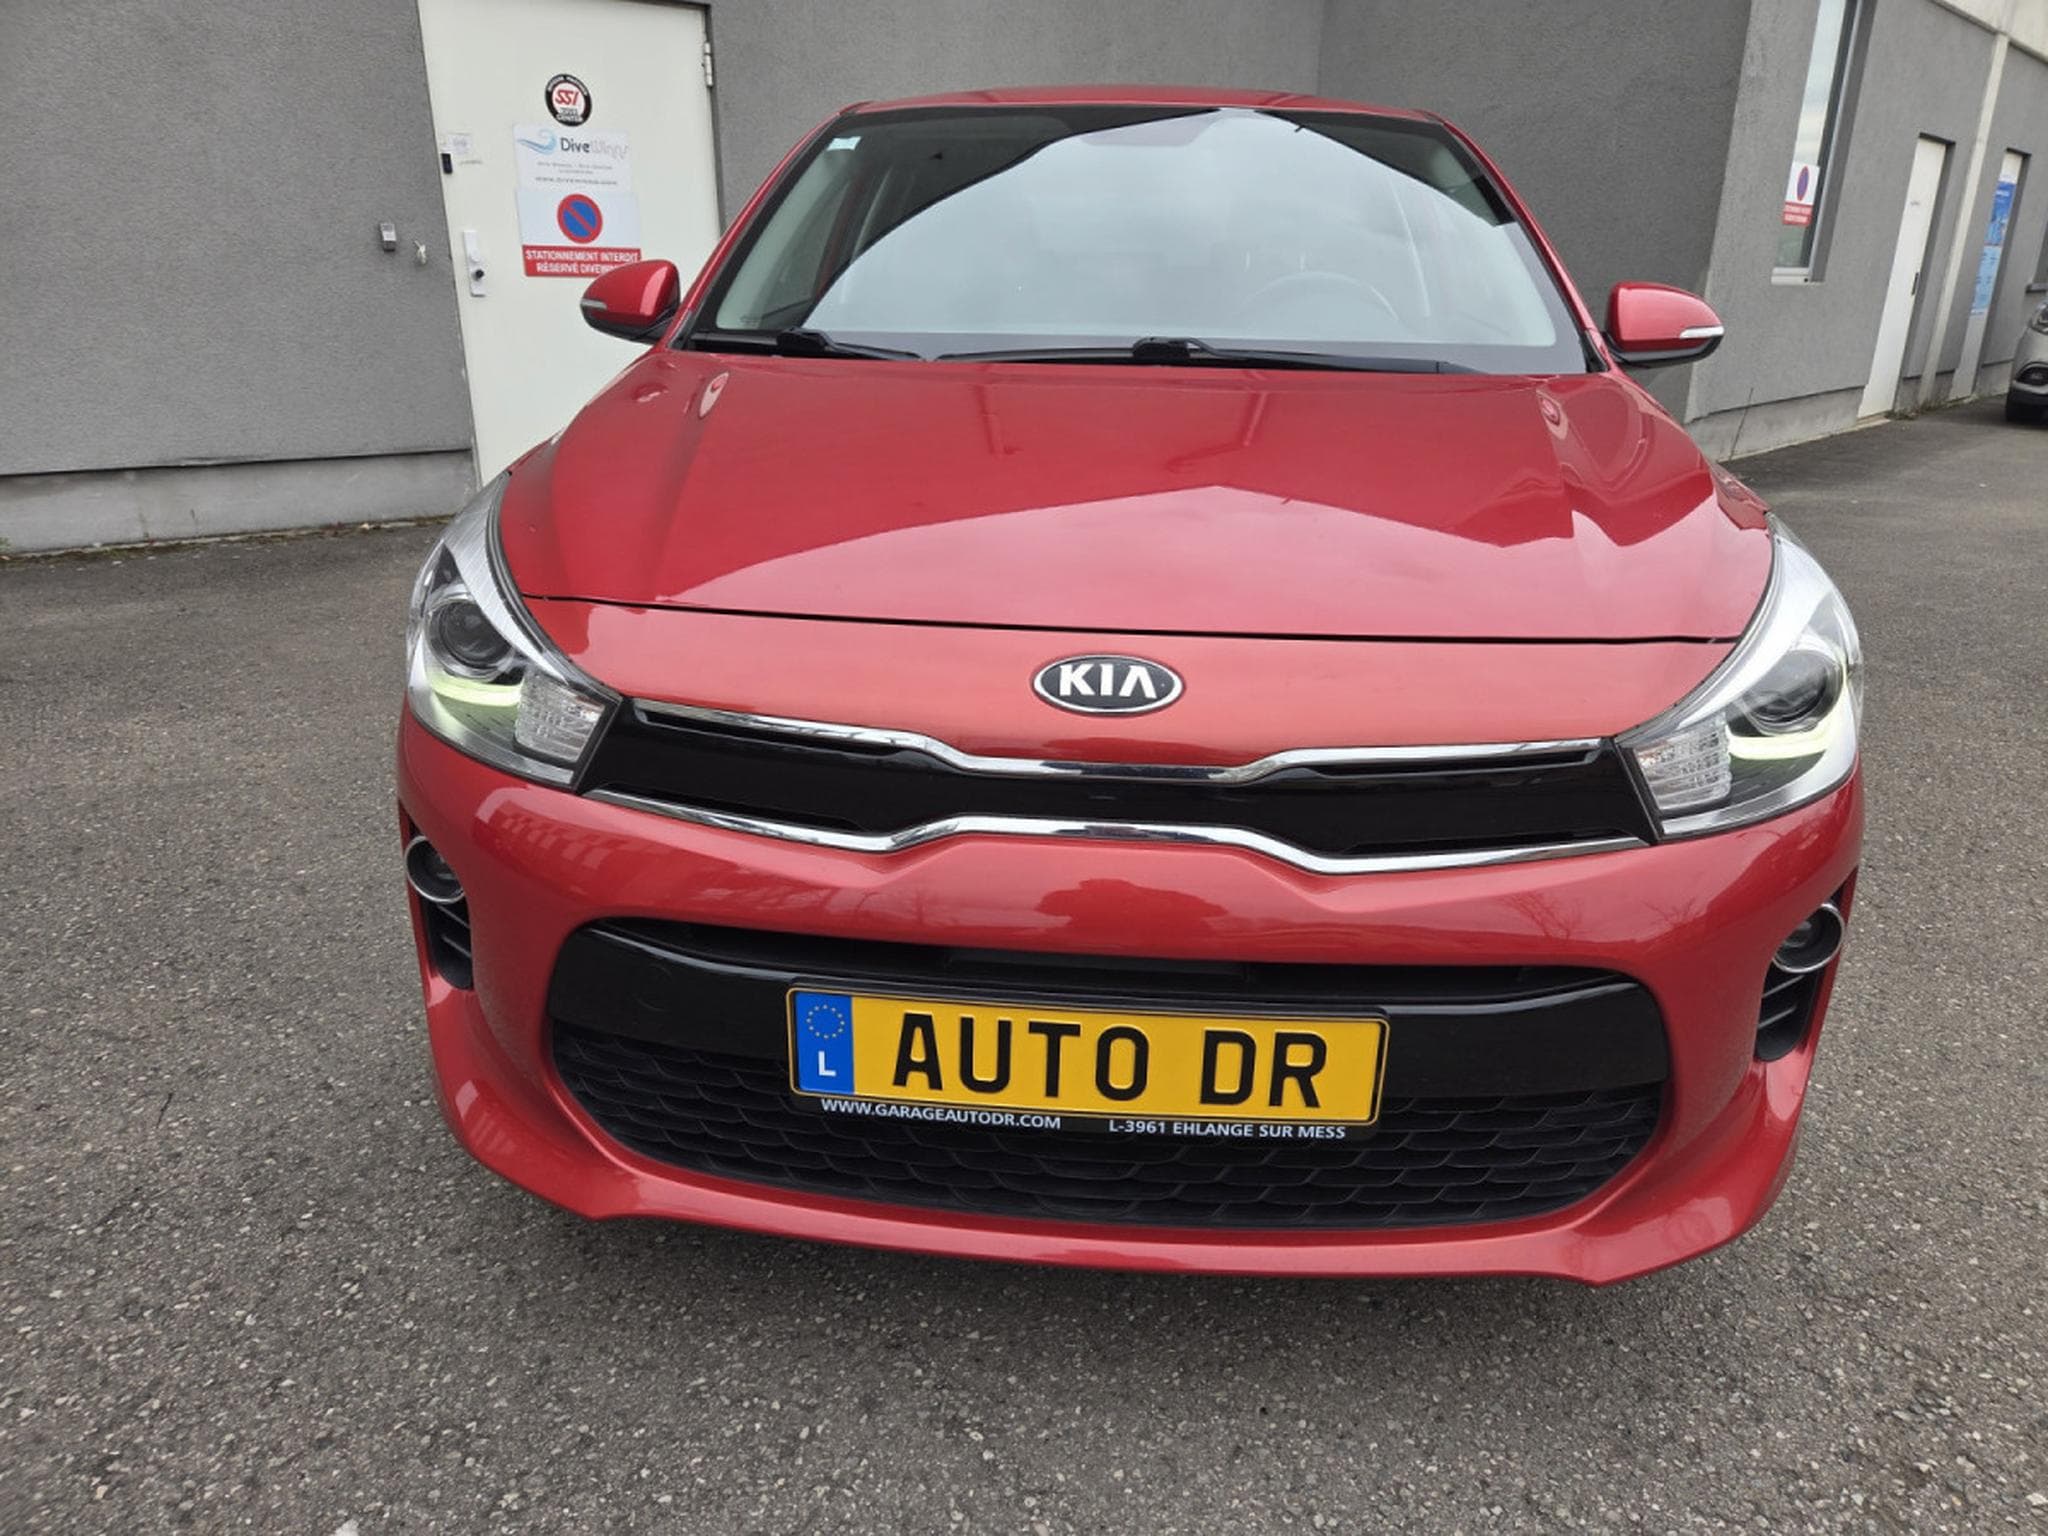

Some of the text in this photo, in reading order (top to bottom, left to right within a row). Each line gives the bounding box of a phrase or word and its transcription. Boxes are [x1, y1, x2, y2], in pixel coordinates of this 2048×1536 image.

[555, 89, 579, 106] SSI
[525, 249, 639, 263] STATIONNEMENT INTERDIT
[1059, 663, 1158, 699] KIA
[818, 1050, 837, 1078] L
[892, 1011, 1328, 1109] AUTO DR
[820, 1098, 1062, 1130] WWW.GARAGEAUTODR.COM
[1108, 1119, 1347, 1140] L-3961 EHLANGE SUR MESS
